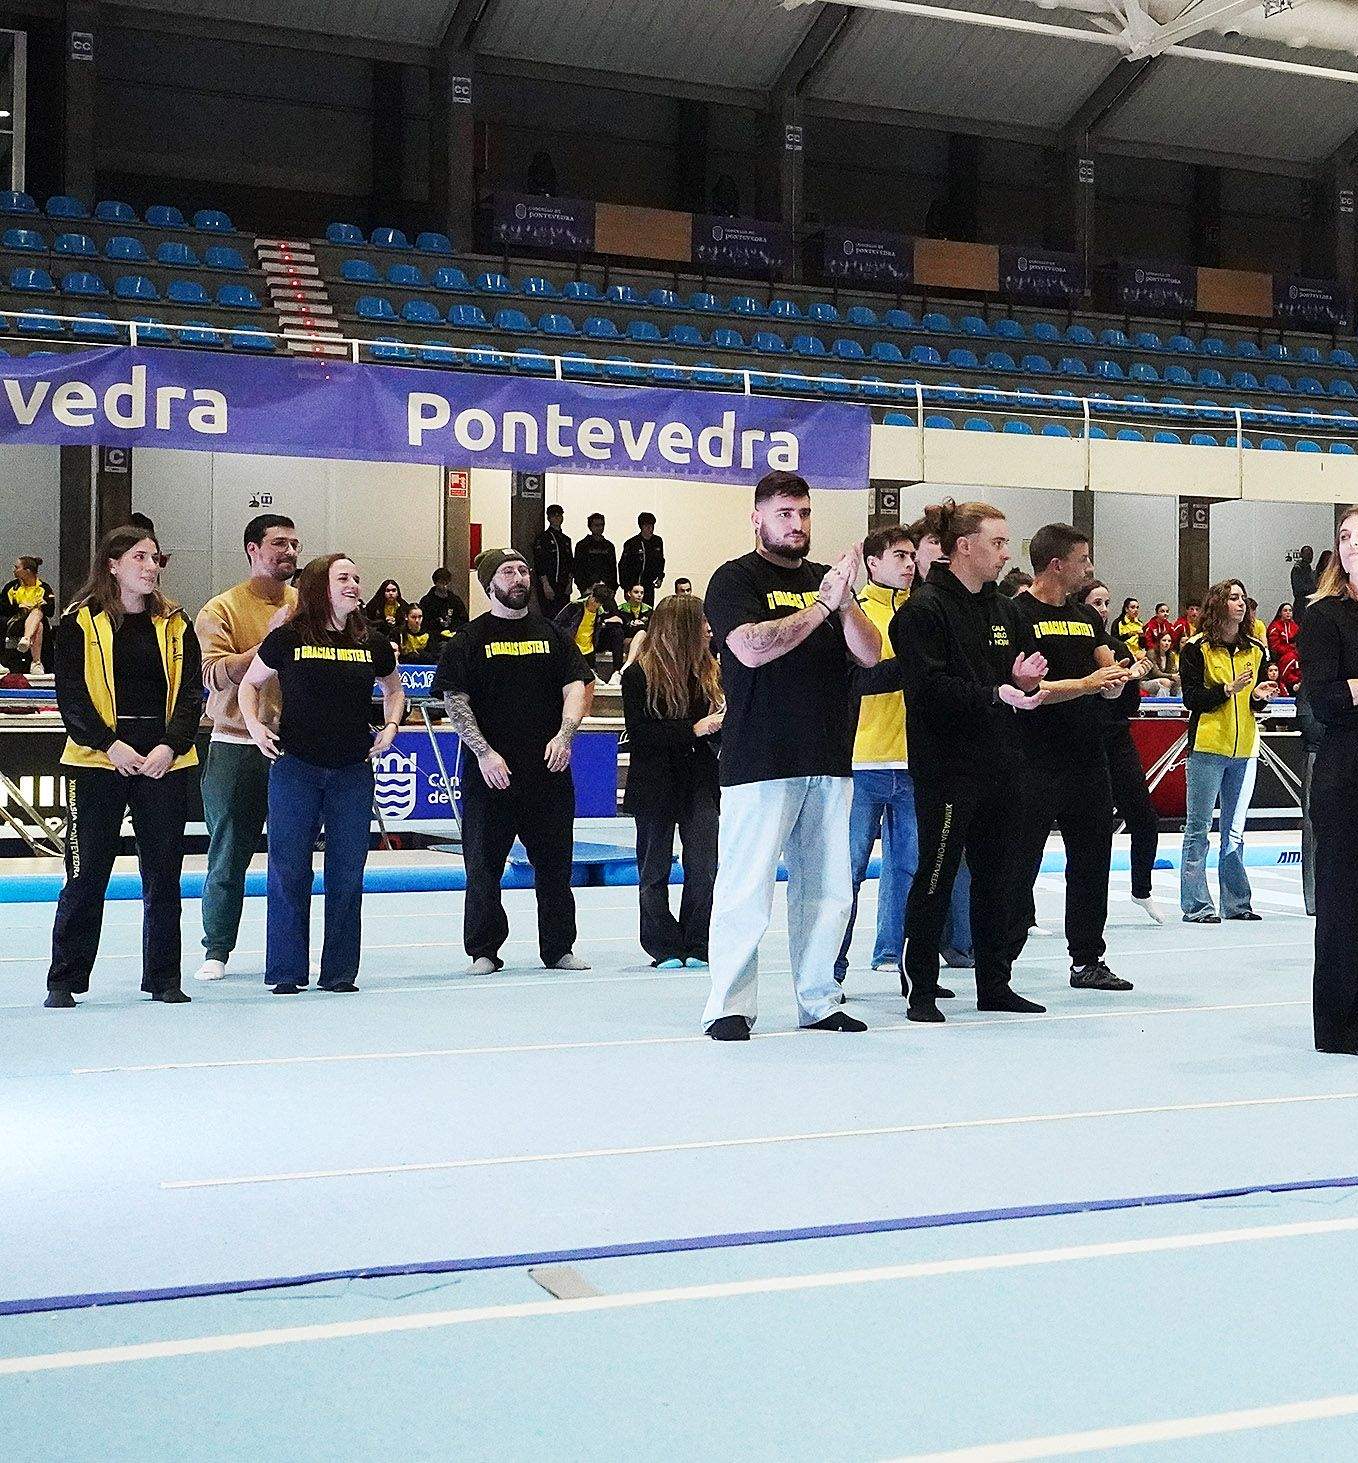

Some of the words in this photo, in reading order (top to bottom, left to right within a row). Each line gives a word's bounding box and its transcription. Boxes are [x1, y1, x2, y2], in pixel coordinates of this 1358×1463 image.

[74, 41, 91, 51] CC
[454, 85, 470, 95] CC
[3, 365, 228, 434] vedra
[407, 392, 800, 472] Pontevedra
[109, 449, 124, 465] C
[525, 476, 539, 490] C
[883, 494, 895, 508] C
[1195, 508, 1206, 522] C
[301, 645, 336, 660] GRACIAS
[336, 648, 366, 662] MISTER
[491, 641, 519, 656] GRACIAS
[69, 779, 78, 821] XIMNASIA
[428, 790, 448, 804] de
[941, 803, 953, 842] XIMNASIA
[928, 842, 947, 895] PONTEVEDRA
